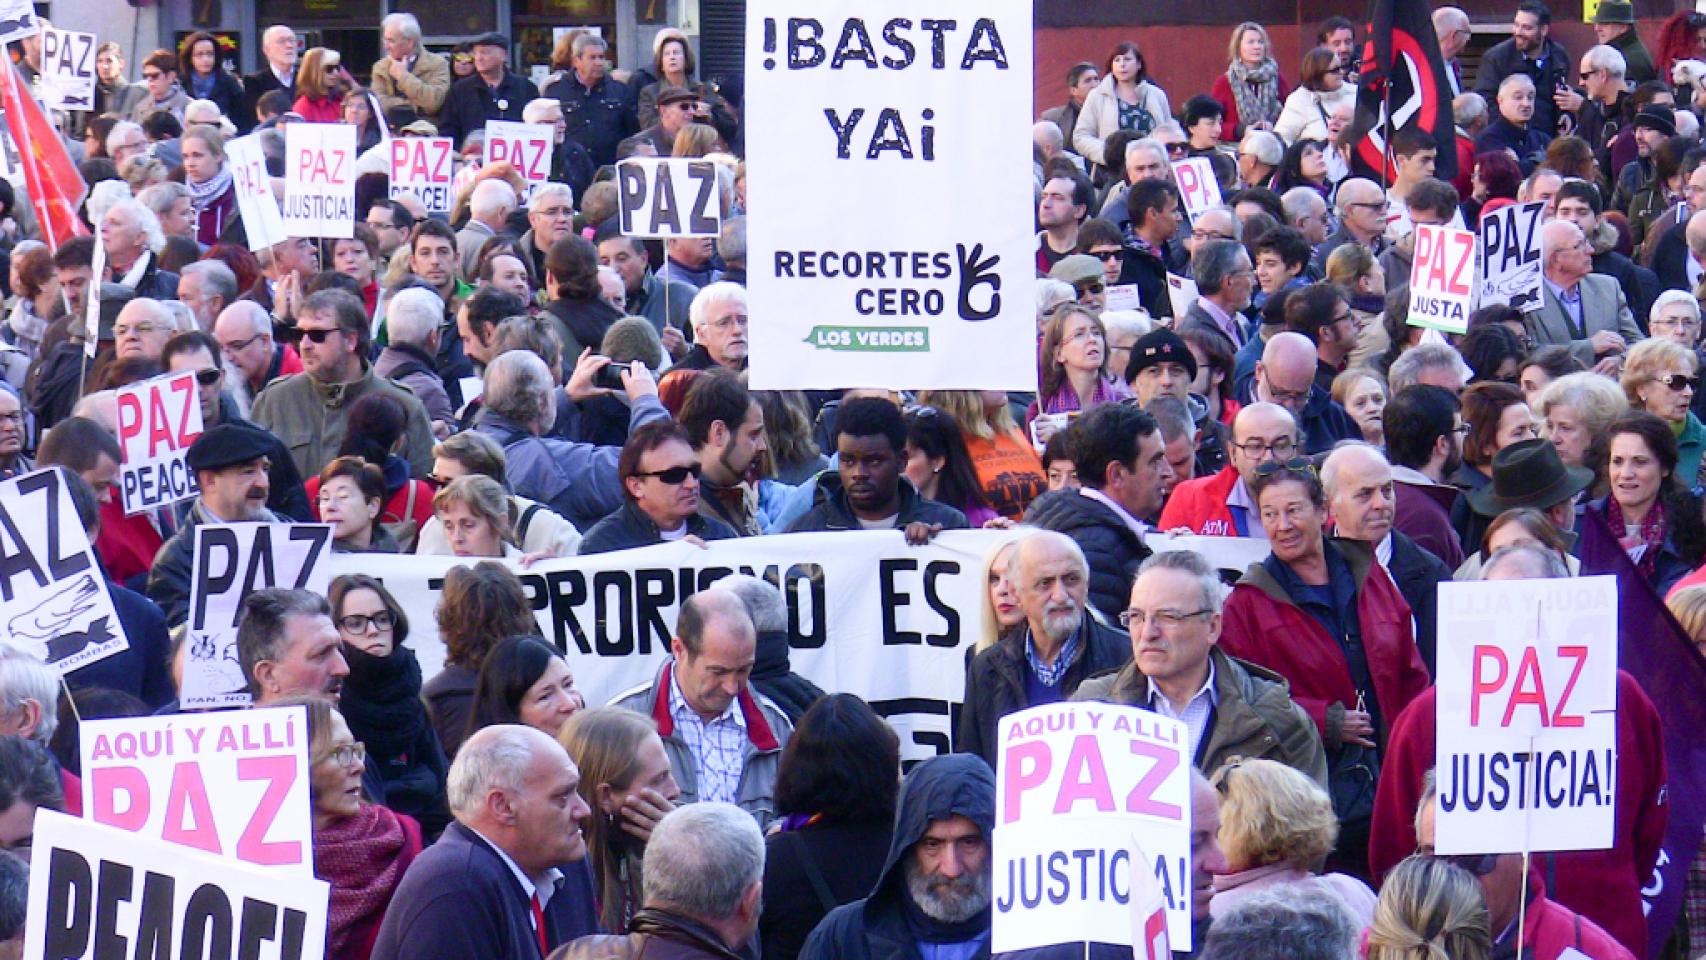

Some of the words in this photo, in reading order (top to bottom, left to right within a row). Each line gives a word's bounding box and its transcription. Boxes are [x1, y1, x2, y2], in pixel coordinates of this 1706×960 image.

[44, 31, 93, 77] PAZ
[763, 17, 1009, 70] !BASTA
[300, 149, 345, 184] PAZ
[392, 139, 450, 182] PAZ
[489, 138, 546, 181] PAZ
[285, 193, 354, 220] JUSTICIA!
[616, 161, 719, 234] PAZ
[774, 250, 952, 279] RECORTES
[1413, 227, 1474, 296] PAZ
[1482, 202, 1544, 280] PAZ
[855, 287, 945, 316] CERO
[1412, 295, 1464, 321] JUSTA
[817, 330, 851, 346] LOS
[856, 331, 924, 347] VERDES
[117, 374, 202, 465] PAZ
[0, 469, 91, 602] AZ
[193, 525, 331, 631] PAZ
[879, 558, 961, 647] ES
[59, 638, 123, 670] BOMBAS
[1469, 643, 1589, 728] PAZ
[91, 722, 174, 761] AQUÍ
[184, 726, 206, 754] Y
[216, 714, 296, 752] ALLÍ
[1007, 708, 1076, 742] AQUÍ
[1086, 711, 1103, 729] Y
[1113, 714, 1180, 745] ALLÍ
[1003, 734, 1183, 825] PAZ
[1440, 749, 1613, 813] JUSTICIA!
[91, 754, 303, 866] PAZ
[997, 848, 1187, 914] JUSTICA!
